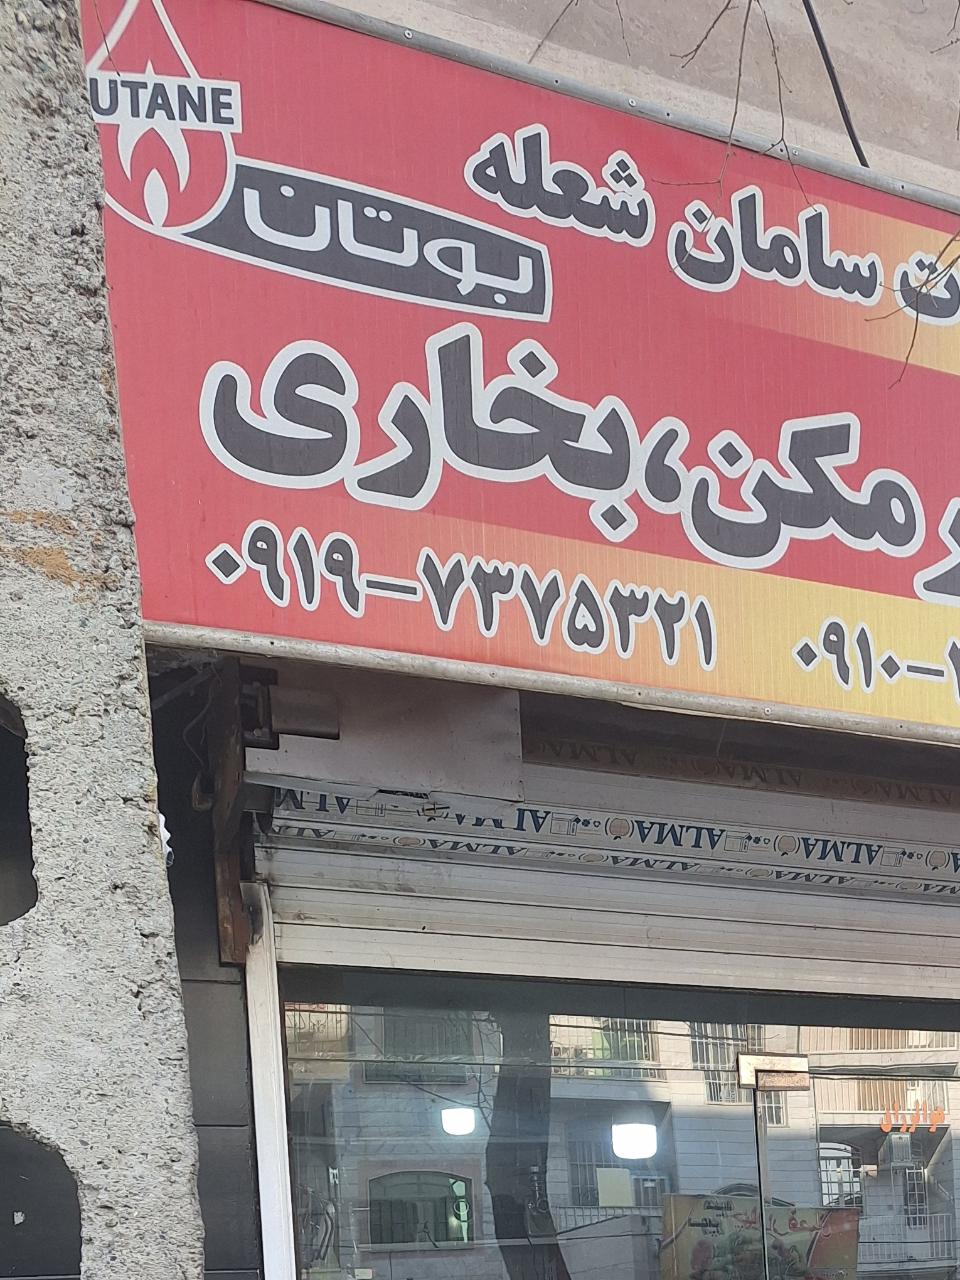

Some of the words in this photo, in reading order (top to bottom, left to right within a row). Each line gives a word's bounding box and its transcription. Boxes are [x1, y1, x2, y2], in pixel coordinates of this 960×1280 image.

[86, 76, 236, 126] UTANE
[471, 130, 650, 242] شعله
[238, 180, 535, 306] بوتان
[673, 191, 880, 300] سامان
[272, 785, 352, 815] ALM
[635, 819, 727, 850] ALMA
[800, 836, 883, 866] ALMA
